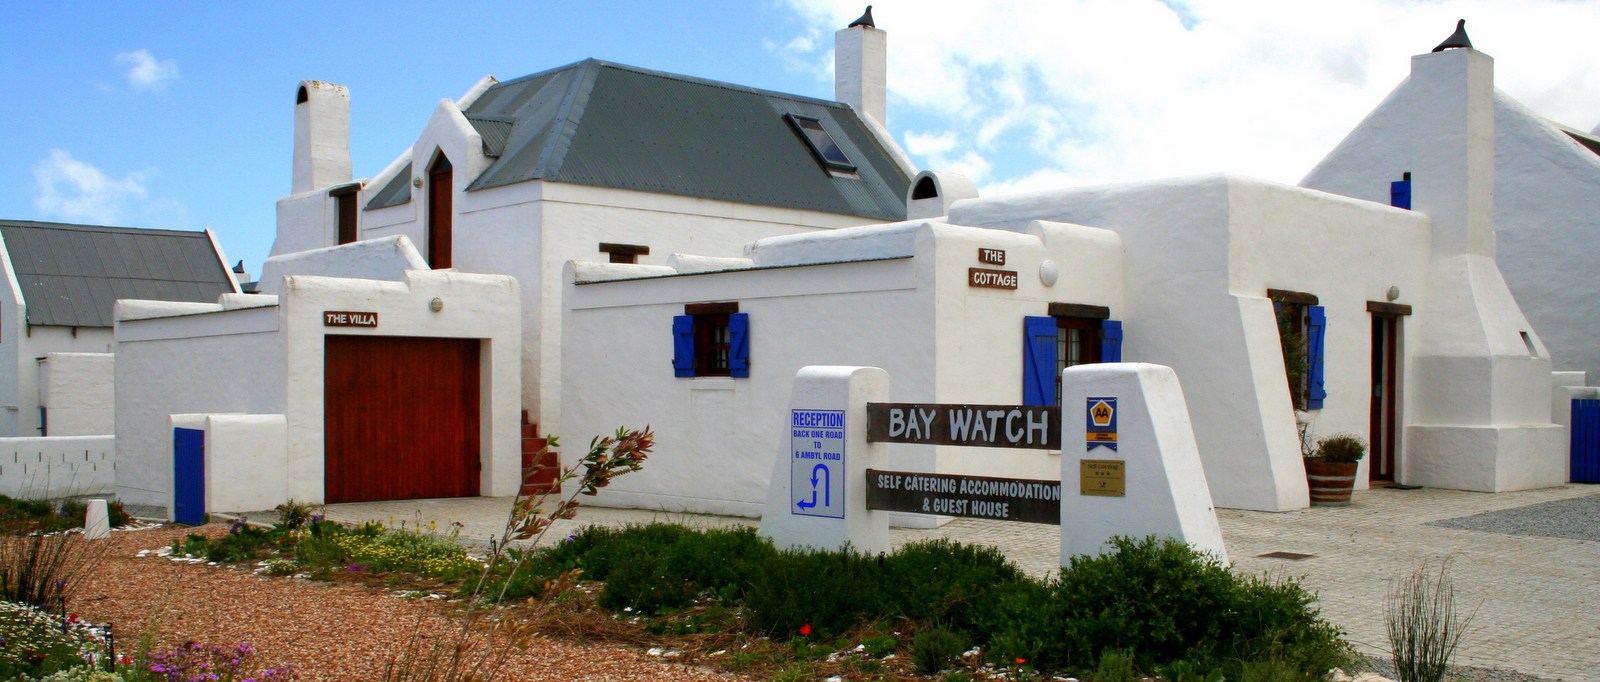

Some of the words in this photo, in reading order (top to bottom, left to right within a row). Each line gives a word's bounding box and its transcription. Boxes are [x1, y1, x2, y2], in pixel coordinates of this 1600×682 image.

[984, 249, 1003, 263] THE
[973, 272, 1017, 287] COTTAGE
[327, 314, 347, 324] THE
[349, 314, 376, 325] VILLA
[793, 412, 843, 427] RECEPTION
[1095, 407, 1108, 418] AA
[888, 407, 937, 440] BAY
[949, 408, 1049, 445] WATCH
[793, 429, 810, 438] BACK
[810, 430, 824, 439] ONE
[825, 431, 843, 439] ROAD
[813, 441, 822, 449] TO
[795, 450, 800, 459] 6
[800, 451, 822, 460] AMBYL
[823, 452, 841, 461] ROAD
[878, 474, 902, 490] SELF
[904, 476, 957, 494] CATERING
[960, 479, 1061, 501] ACCOMMODATION
[922, 497, 931, 512] &
[933, 498, 969, 515] GUEST
[971, 500, 1009, 518] HOUSE
